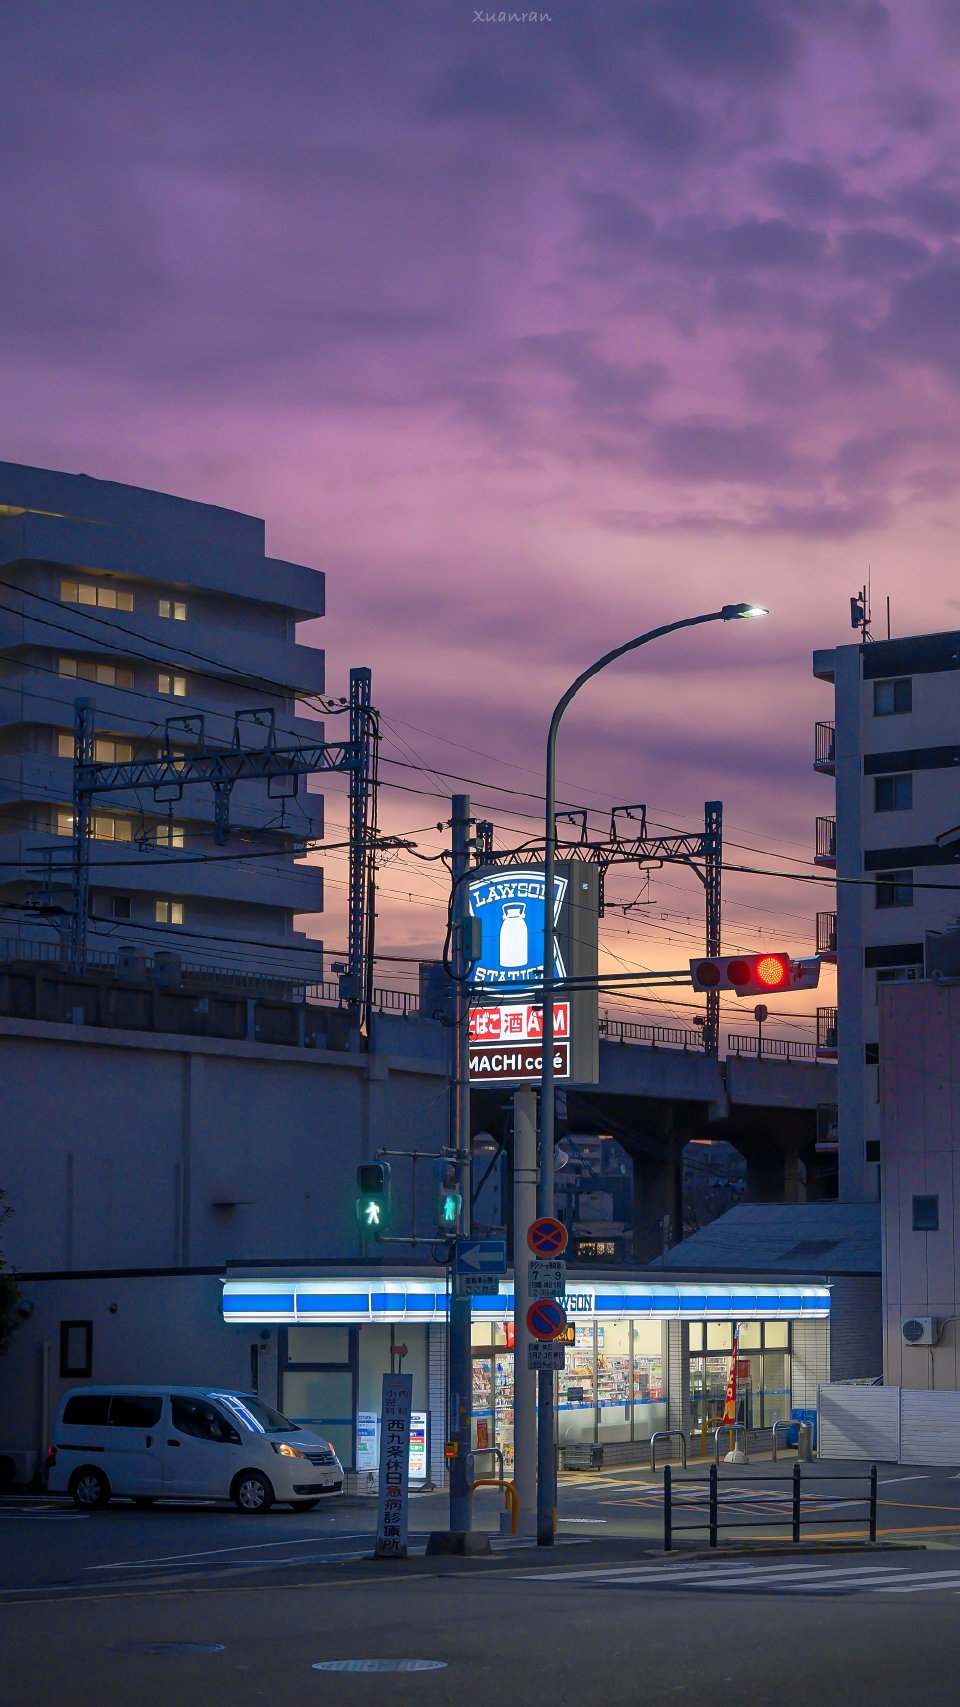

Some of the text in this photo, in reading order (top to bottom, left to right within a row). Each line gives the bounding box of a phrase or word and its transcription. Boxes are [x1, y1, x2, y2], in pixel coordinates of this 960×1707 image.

[474, 964, 545, 982] STATIO
[503, 1012, 523, 1033] 酒
[527, 1009, 565, 1032] AM
[469, 1052, 563, 1072] MACHI caé
[555, 1294, 593, 1311] WSON
[383, 1419, 405, 1551] 西九条休日急病診療所
